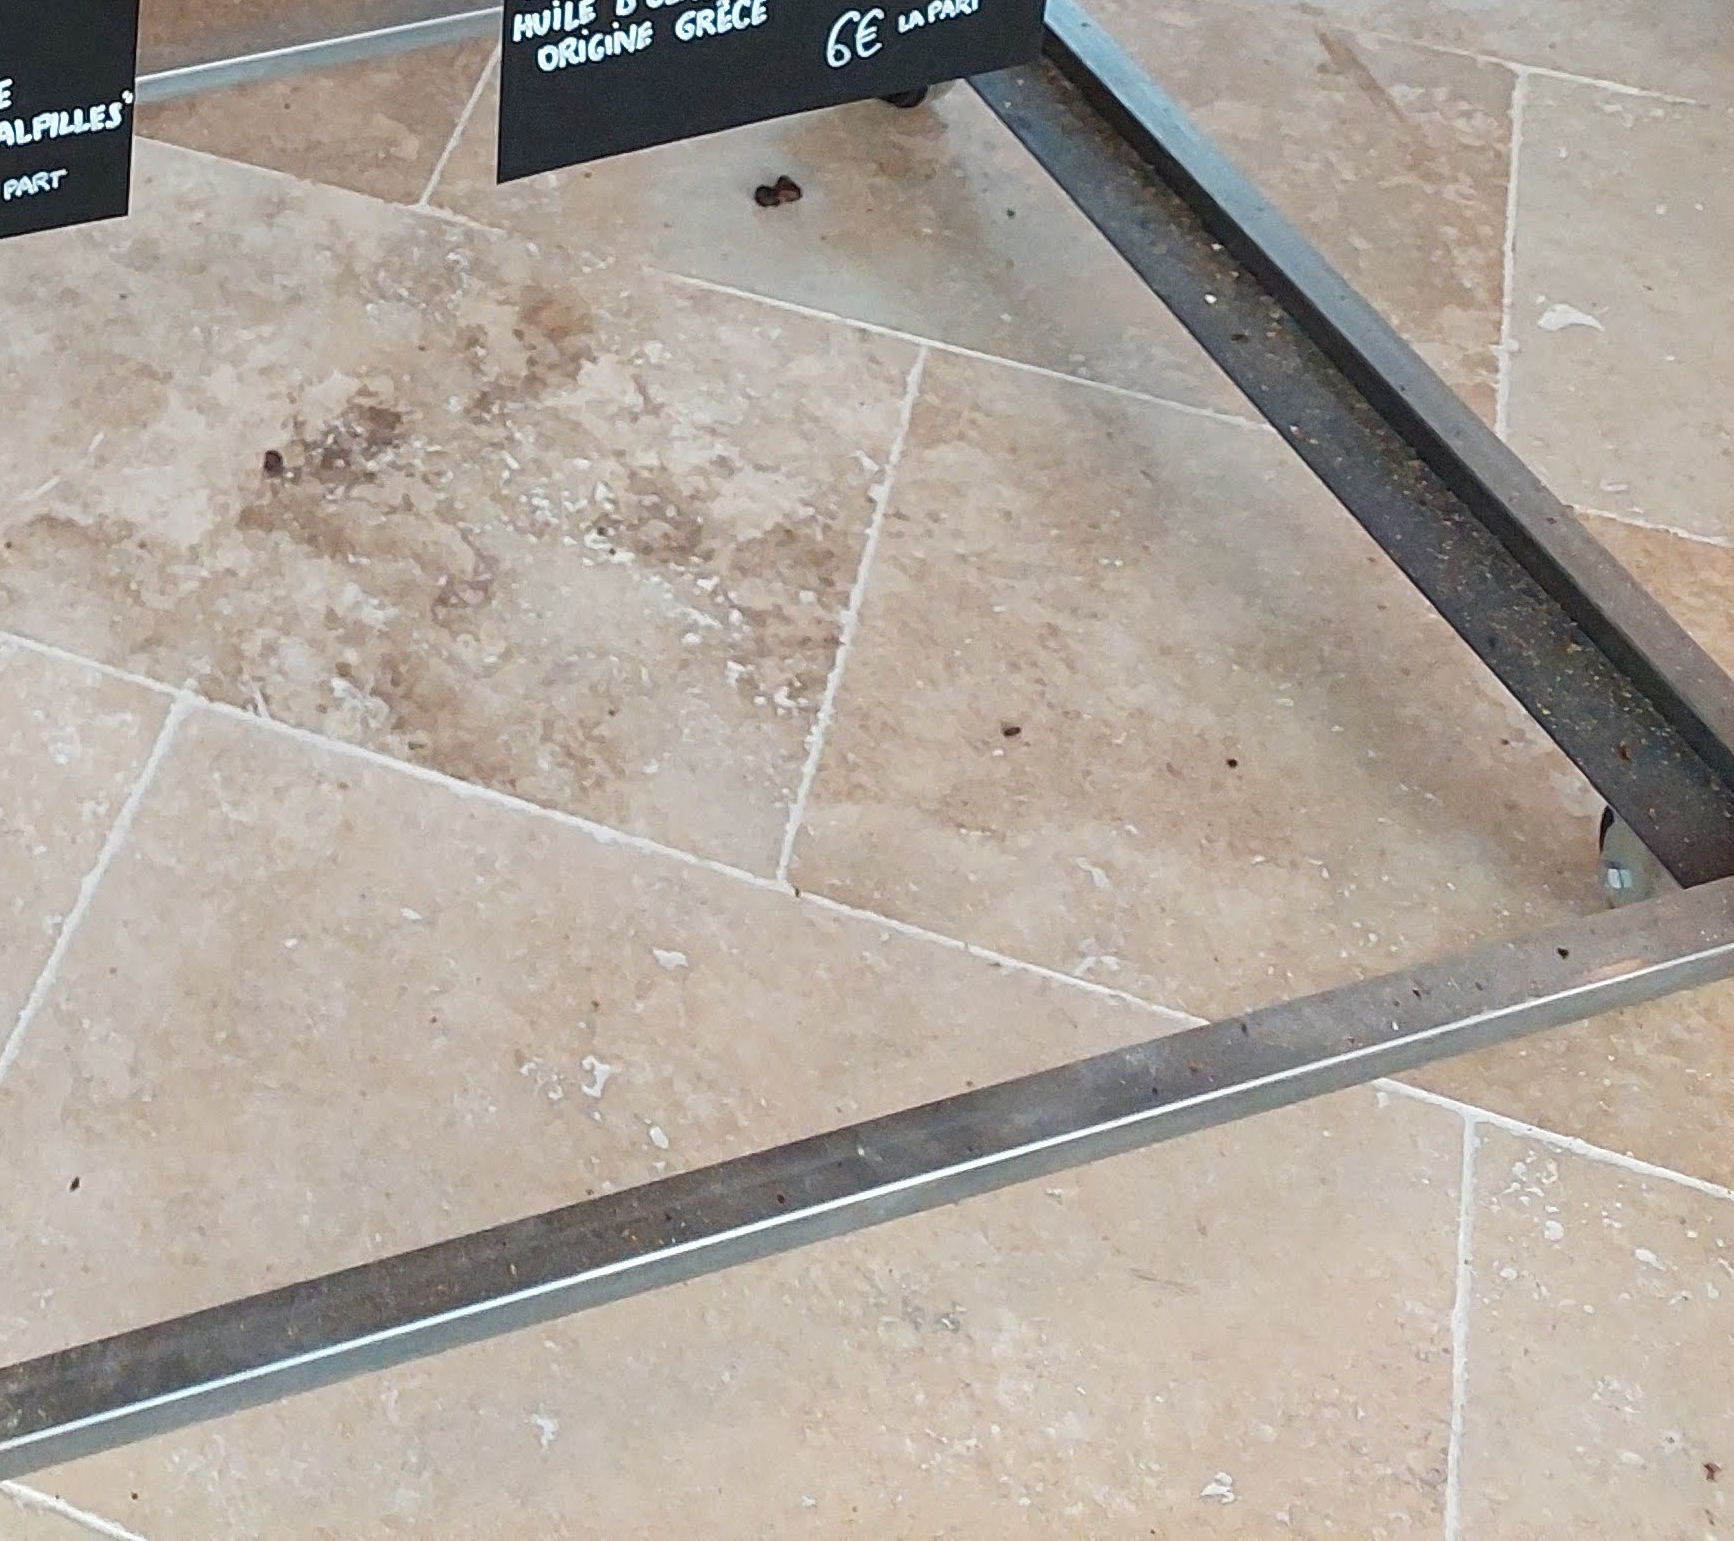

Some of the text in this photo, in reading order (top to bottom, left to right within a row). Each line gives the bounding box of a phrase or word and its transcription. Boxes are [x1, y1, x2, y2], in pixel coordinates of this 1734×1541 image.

[826, 8, 885, 68] 6€
[897, 13, 924, 34] LA
[3, 169, 68, 203] PART
